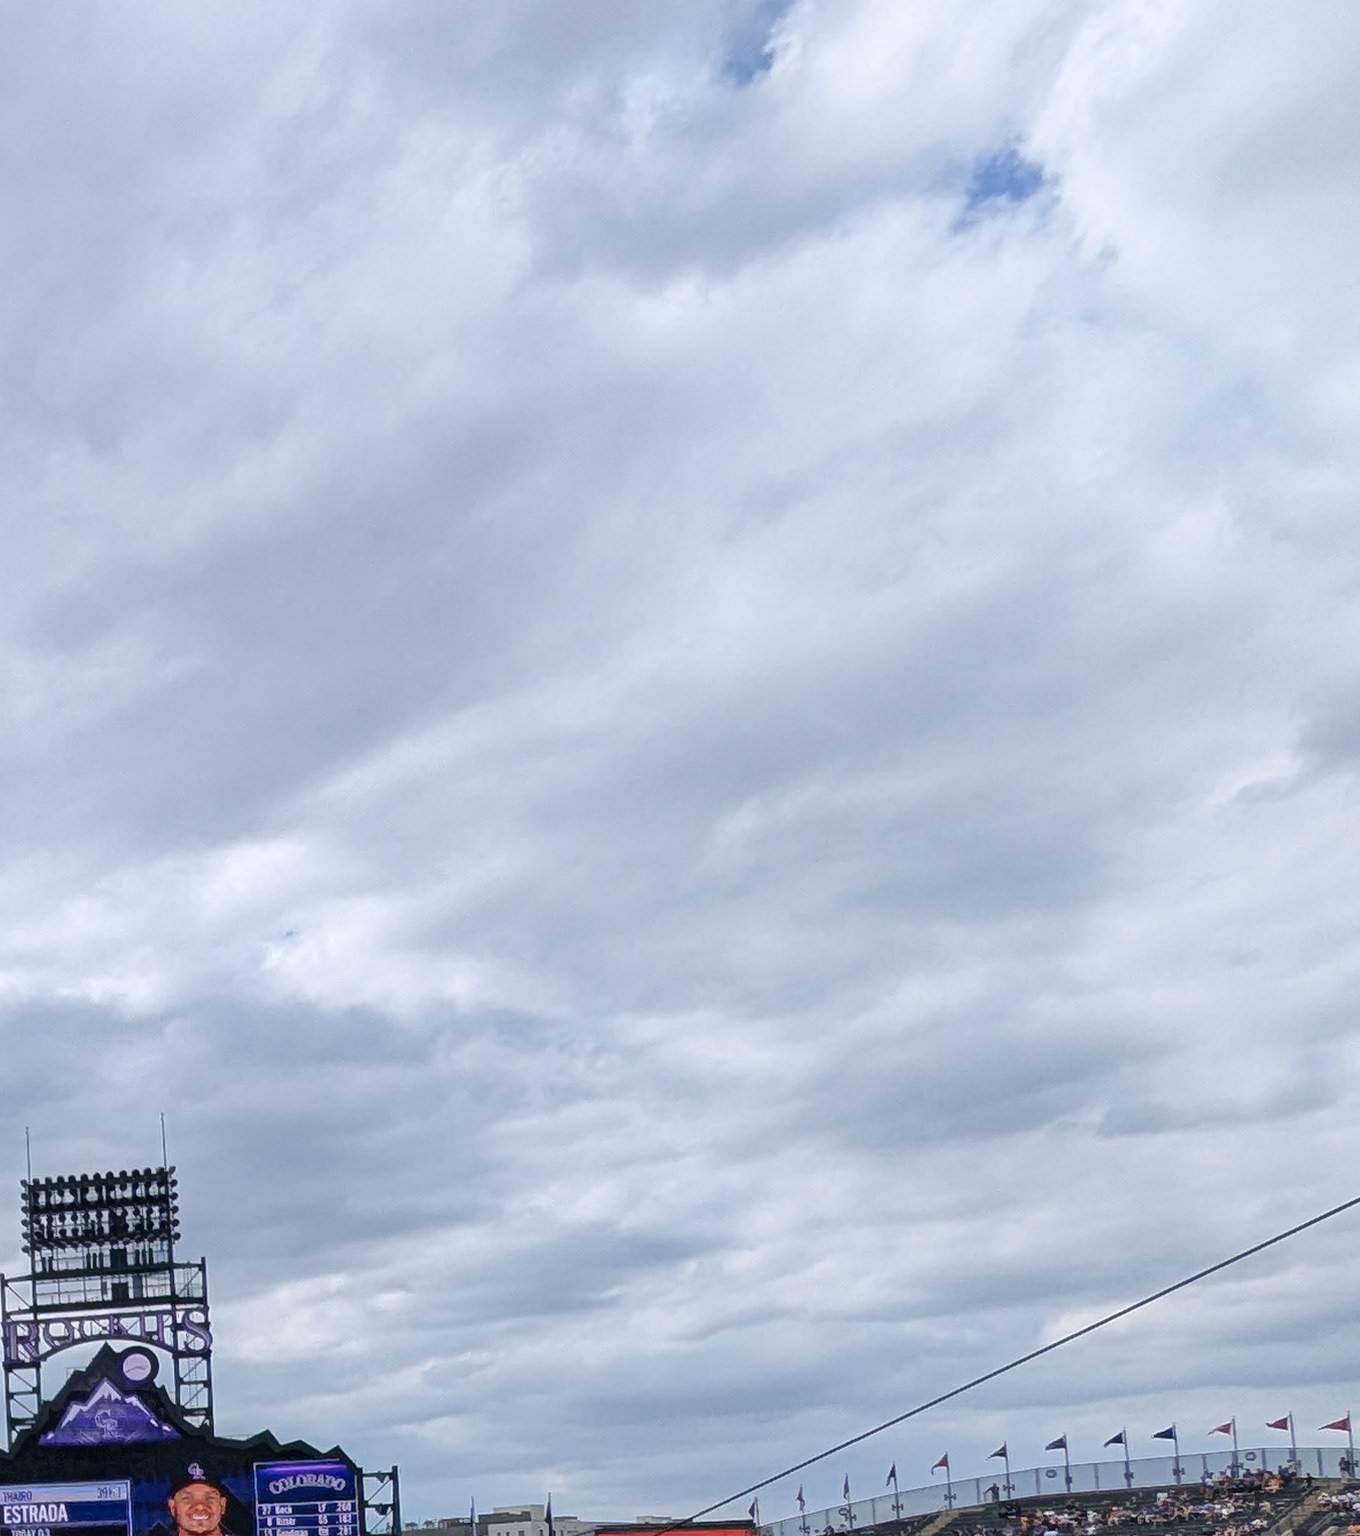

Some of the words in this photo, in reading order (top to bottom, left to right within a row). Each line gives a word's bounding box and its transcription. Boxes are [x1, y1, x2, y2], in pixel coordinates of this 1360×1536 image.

[3, 1308, 212, 1362] ROCKIES
[269, 1474, 346, 1494] COLORADO
[3, 1504, 68, 1524] ESTRADA
